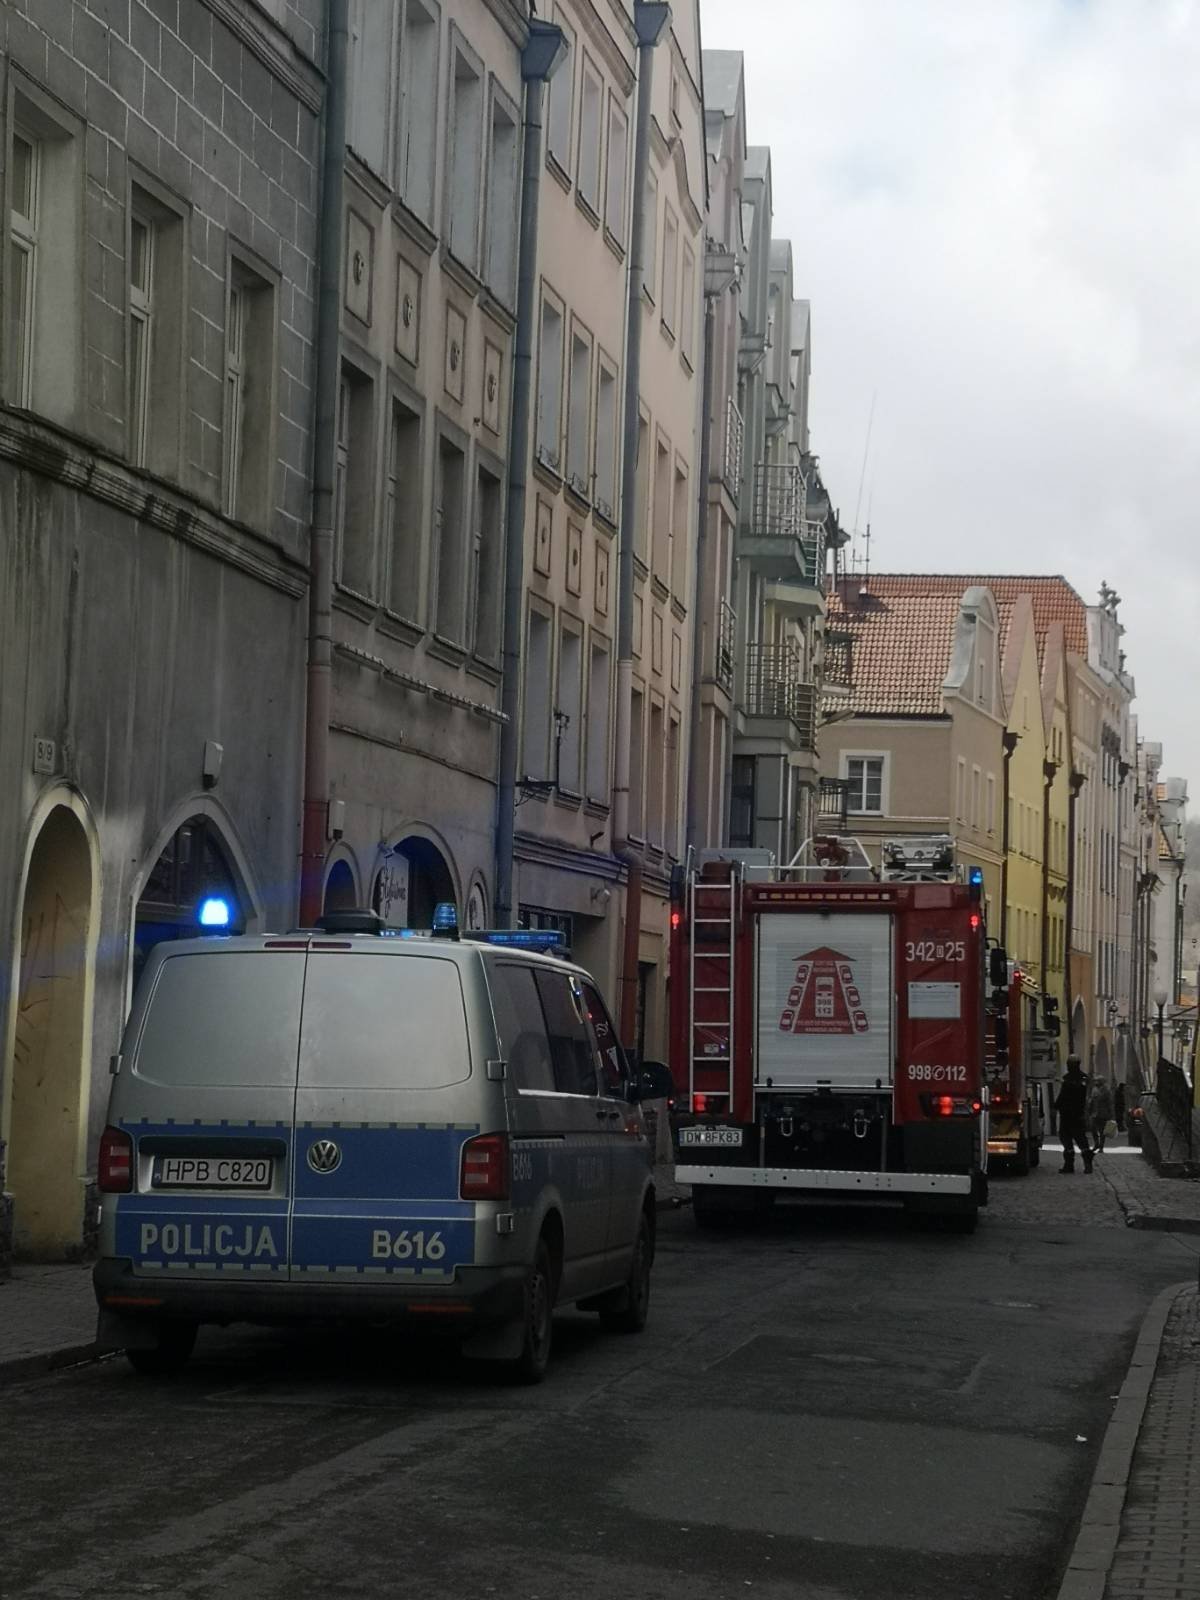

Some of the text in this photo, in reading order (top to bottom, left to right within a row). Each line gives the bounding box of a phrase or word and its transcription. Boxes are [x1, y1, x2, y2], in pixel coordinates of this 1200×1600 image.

[905, 941, 935, 962] 342
[945, 941, 965, 962] 25
[908, 1064, 967, 1081] 998 112
[686, 1131, 701, 1143] DW
[166, 1160, 266, 1183] HPB C820
[140, 1222, 278, 1257] POLICJA
[372, 1228, 446, 1260] B616
